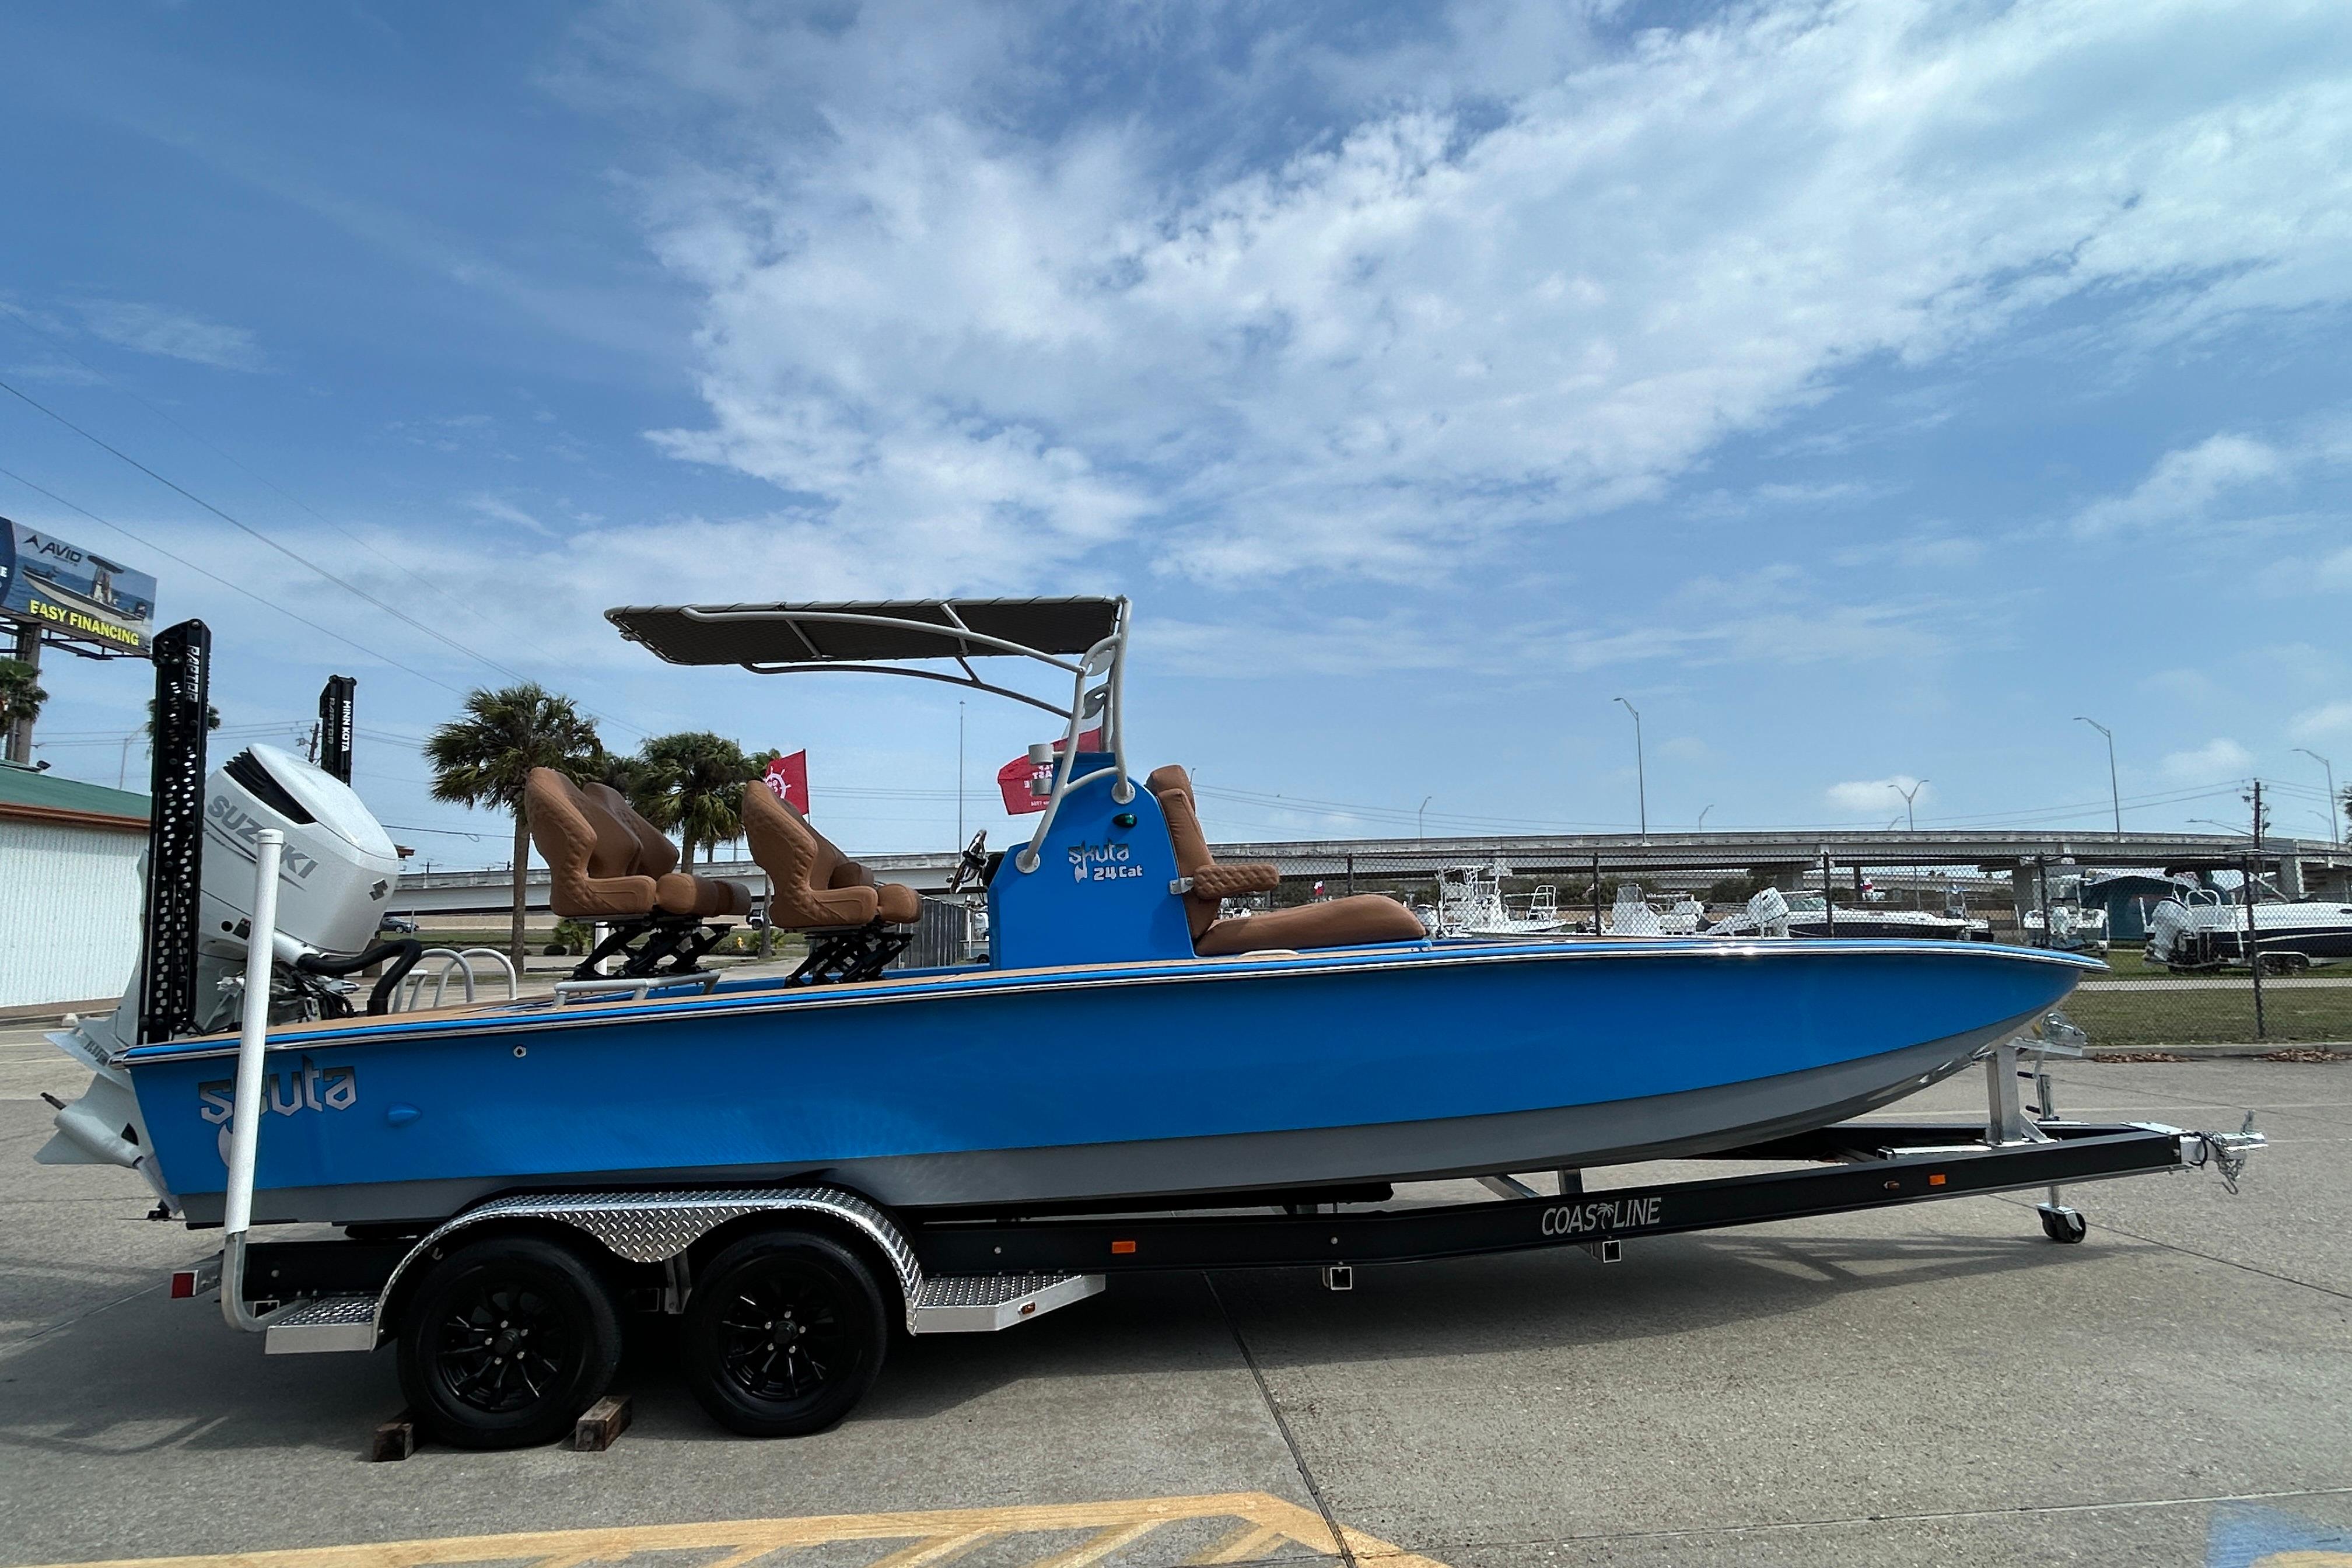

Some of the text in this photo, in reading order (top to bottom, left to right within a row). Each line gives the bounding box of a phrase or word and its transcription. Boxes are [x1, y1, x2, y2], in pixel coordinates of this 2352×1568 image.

[39, 542, 82, 562] AVID
[30, 600, 139, 646] EASY FINANCING
[187, 644, 200, 703] RAPTOR
[341, 700, 351, 752] MINN KOTA
[207, 795, 318, 878] SUZKI
